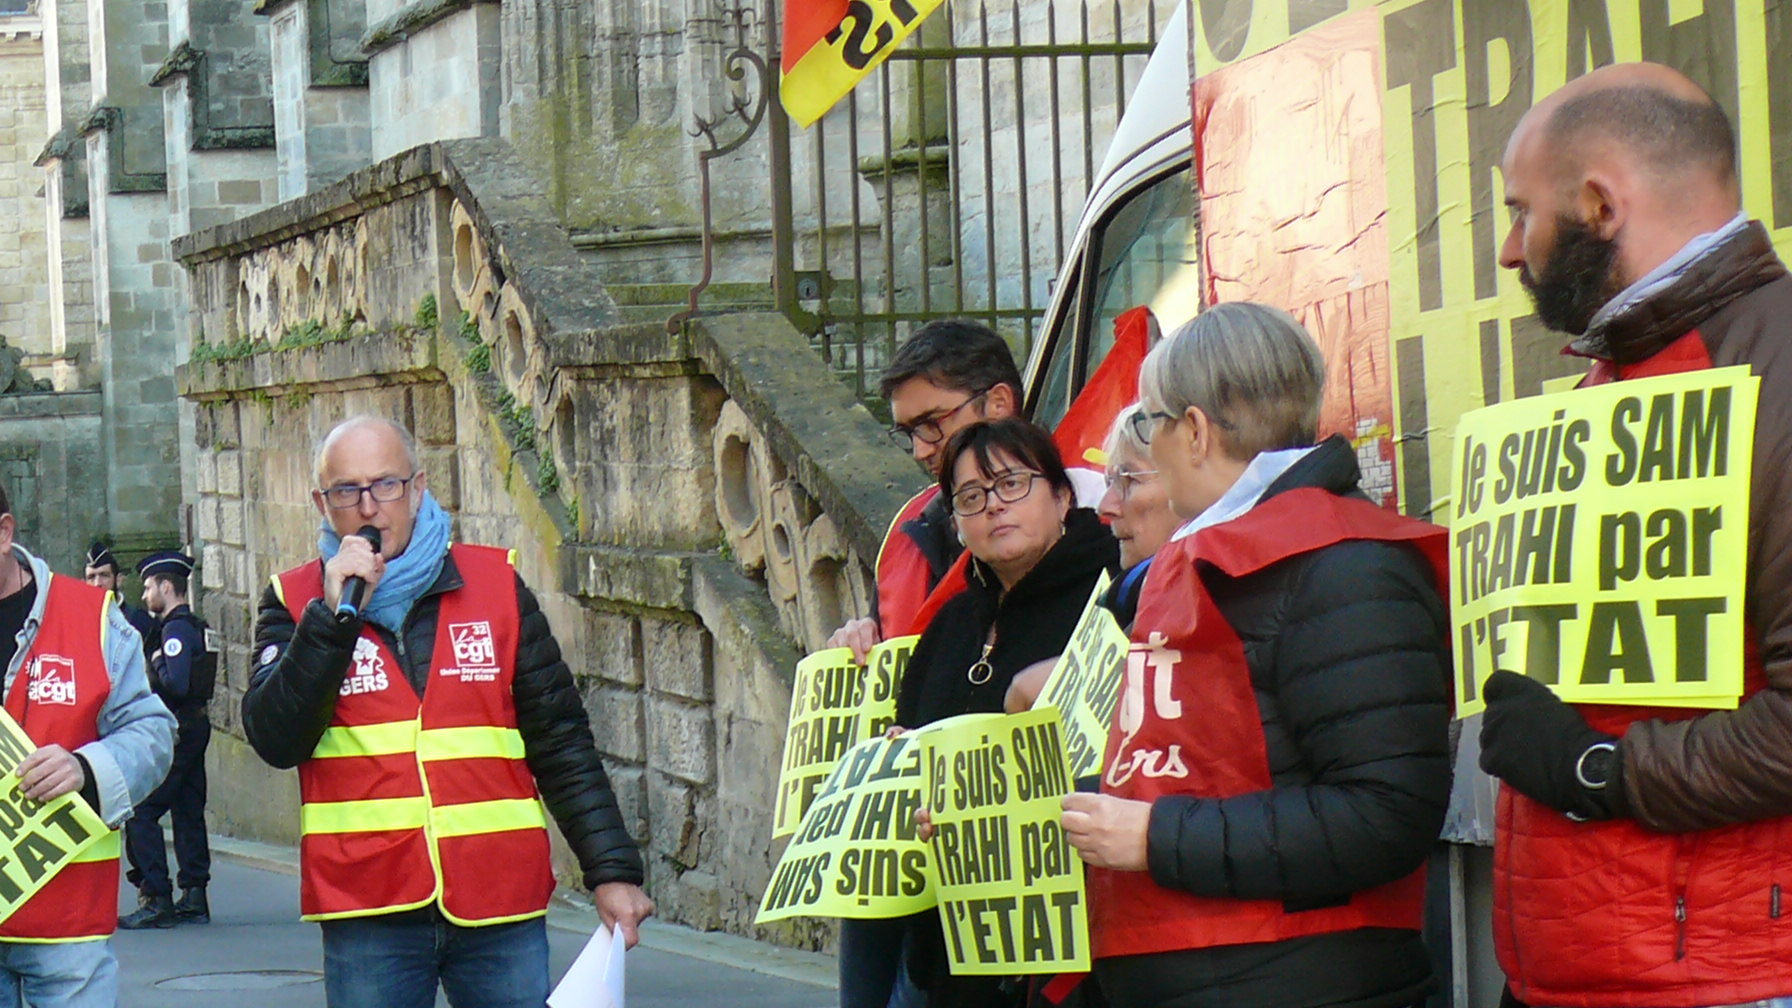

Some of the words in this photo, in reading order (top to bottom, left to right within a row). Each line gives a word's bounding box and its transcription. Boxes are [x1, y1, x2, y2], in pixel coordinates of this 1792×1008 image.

[1457, 434, 1487, 519] Je
[1494, 408, 1591, 505] suis
[1605, 385, 1733, 487] SAM
[1456, 503, 1577, 607] TRAHI
[1599, 504, 1723, 591] par
[455, 637, 493, 662] cgt
[472, 625, 487, 635] 32
[39, 681, 75, 701] cgt
[340, 674, 389, 696] GERS
[810, 658, 869, 711] suis
[873, 647, 911, 702] SA
[787, 713, 861, 772] TRAHI
[927, 746, 946, 814] Je
[954, 735, 1008, 811] suis
[1011, 722, 1068, 802] SAM
[849, 789, 921, 841] AHI
[836, 848, 927, 906] suis
[932, 815, 1012, 887] TRAHI
[765, 850, 831, 912] SAM
